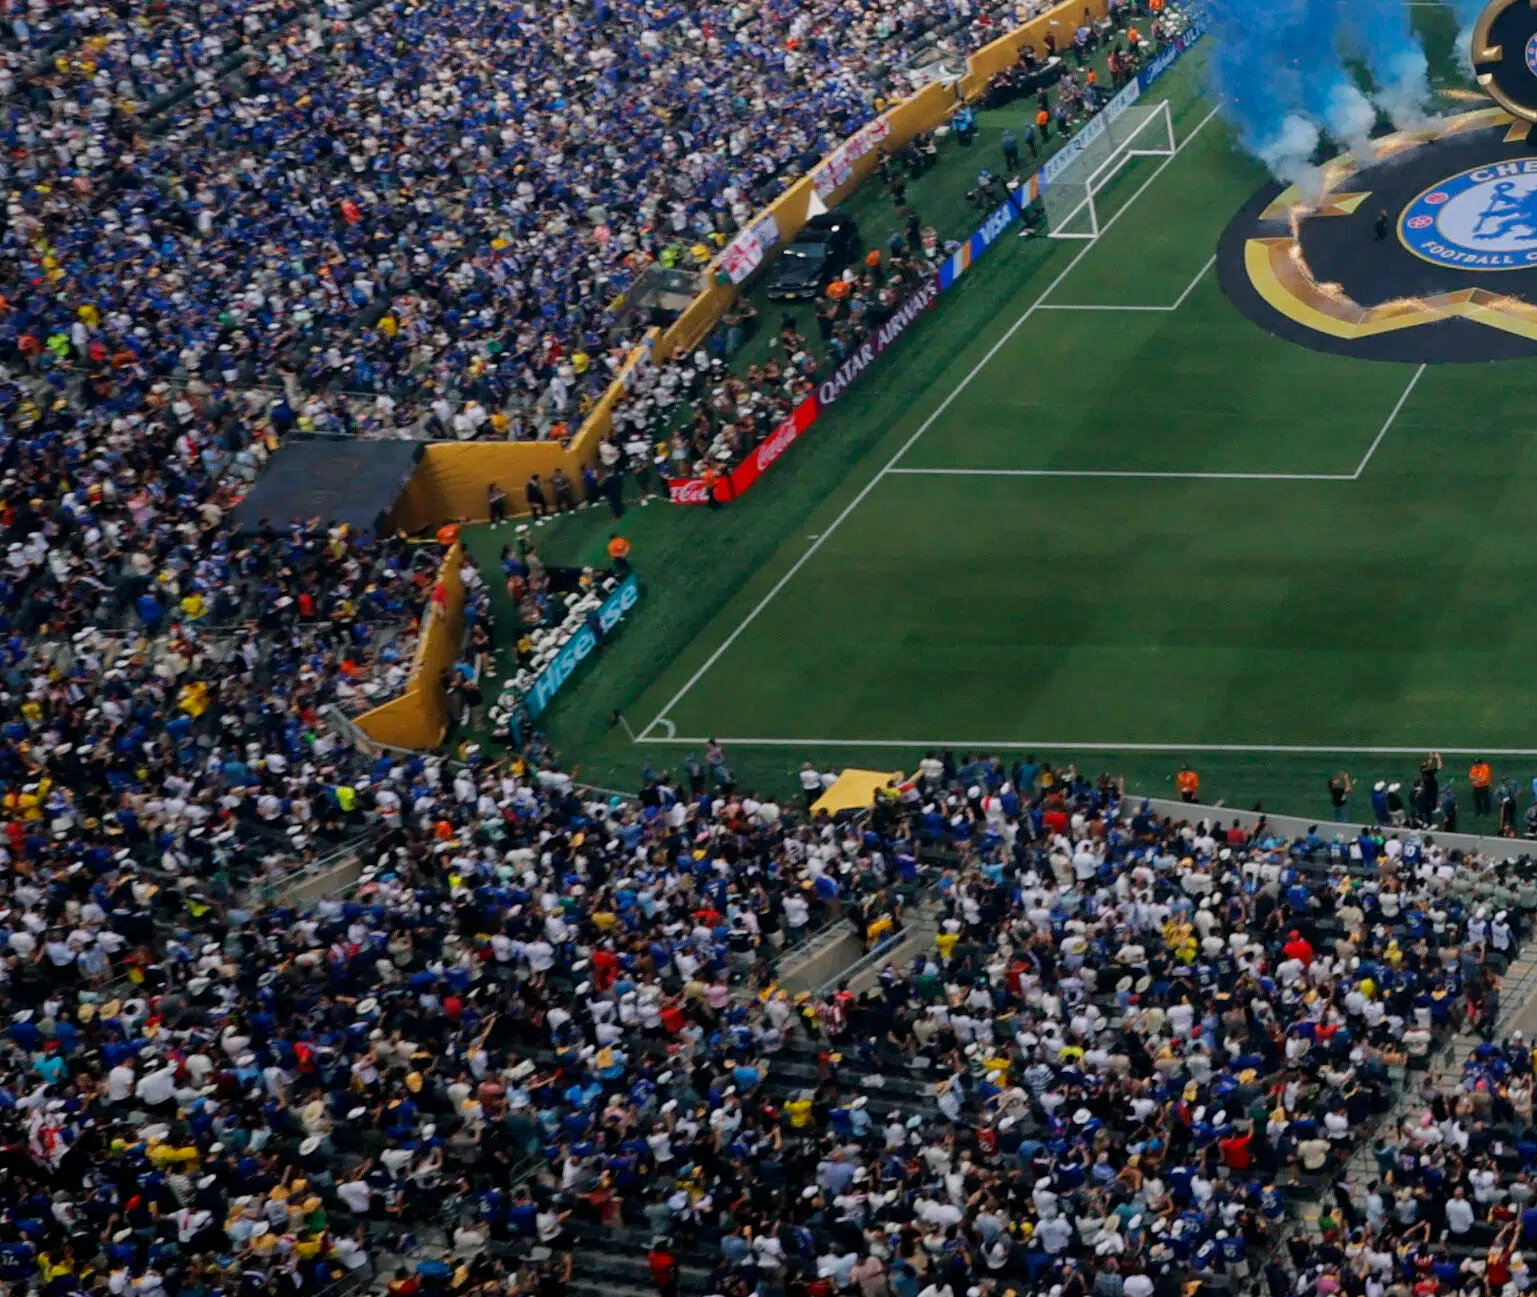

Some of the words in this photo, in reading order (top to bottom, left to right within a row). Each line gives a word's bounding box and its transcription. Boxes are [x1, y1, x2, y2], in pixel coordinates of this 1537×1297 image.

[1421, 240, 1513, 264] FOOTBALL
[818, 343, 874, 404] QATAR
[878, 281, 939, 350] AIRWAYS
